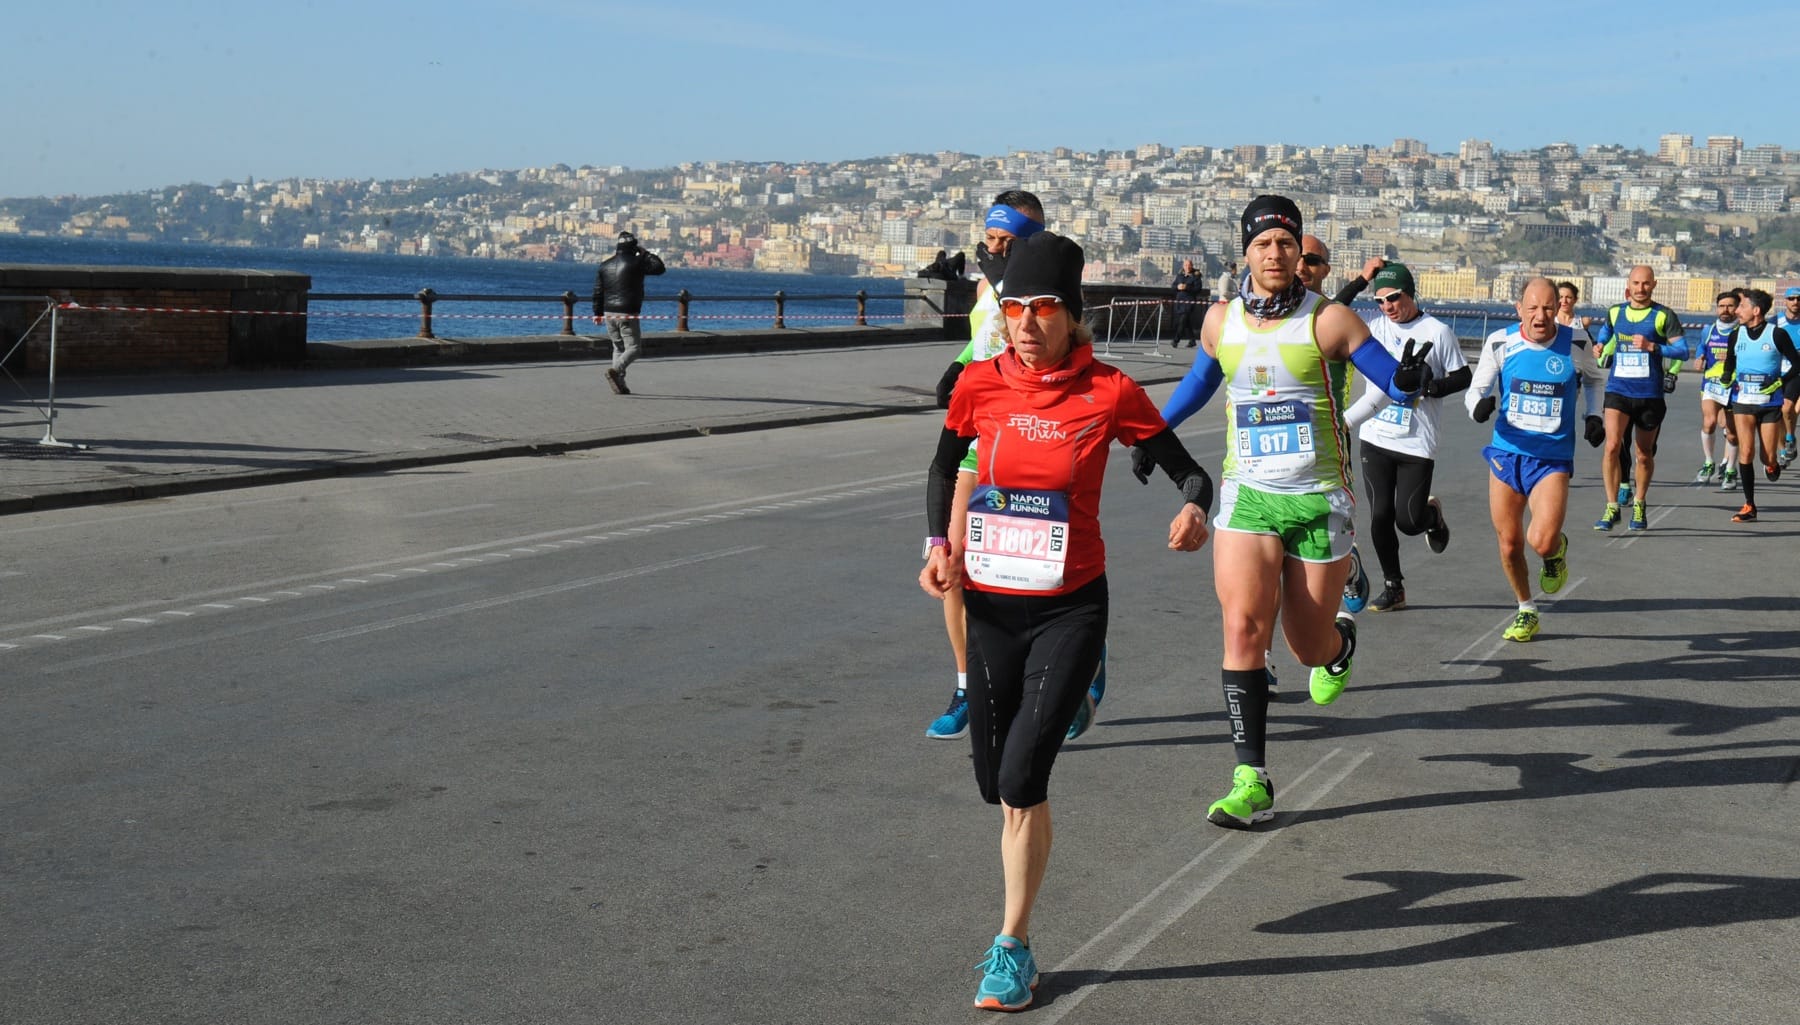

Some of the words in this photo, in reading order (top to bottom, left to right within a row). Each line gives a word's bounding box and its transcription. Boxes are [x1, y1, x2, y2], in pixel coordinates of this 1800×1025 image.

[1264, 405, 1295, 415] NAPOLI
[1522, 399, 1547, 415] 833
[1007, 415, 1061, 430] SPORT
[1265, 413, 1295, 422] RUNNING
[1018, 427, 1066, 441] TOWN
[1259, 432, 1288, 453] 817
[1009, 493, 1050, 507] NAPOLI
[1010, 503, 1050, 515] RUNNING
[986, 524, 1047, 556] F1802
[1224, 684, 1247, 743] kalenji
